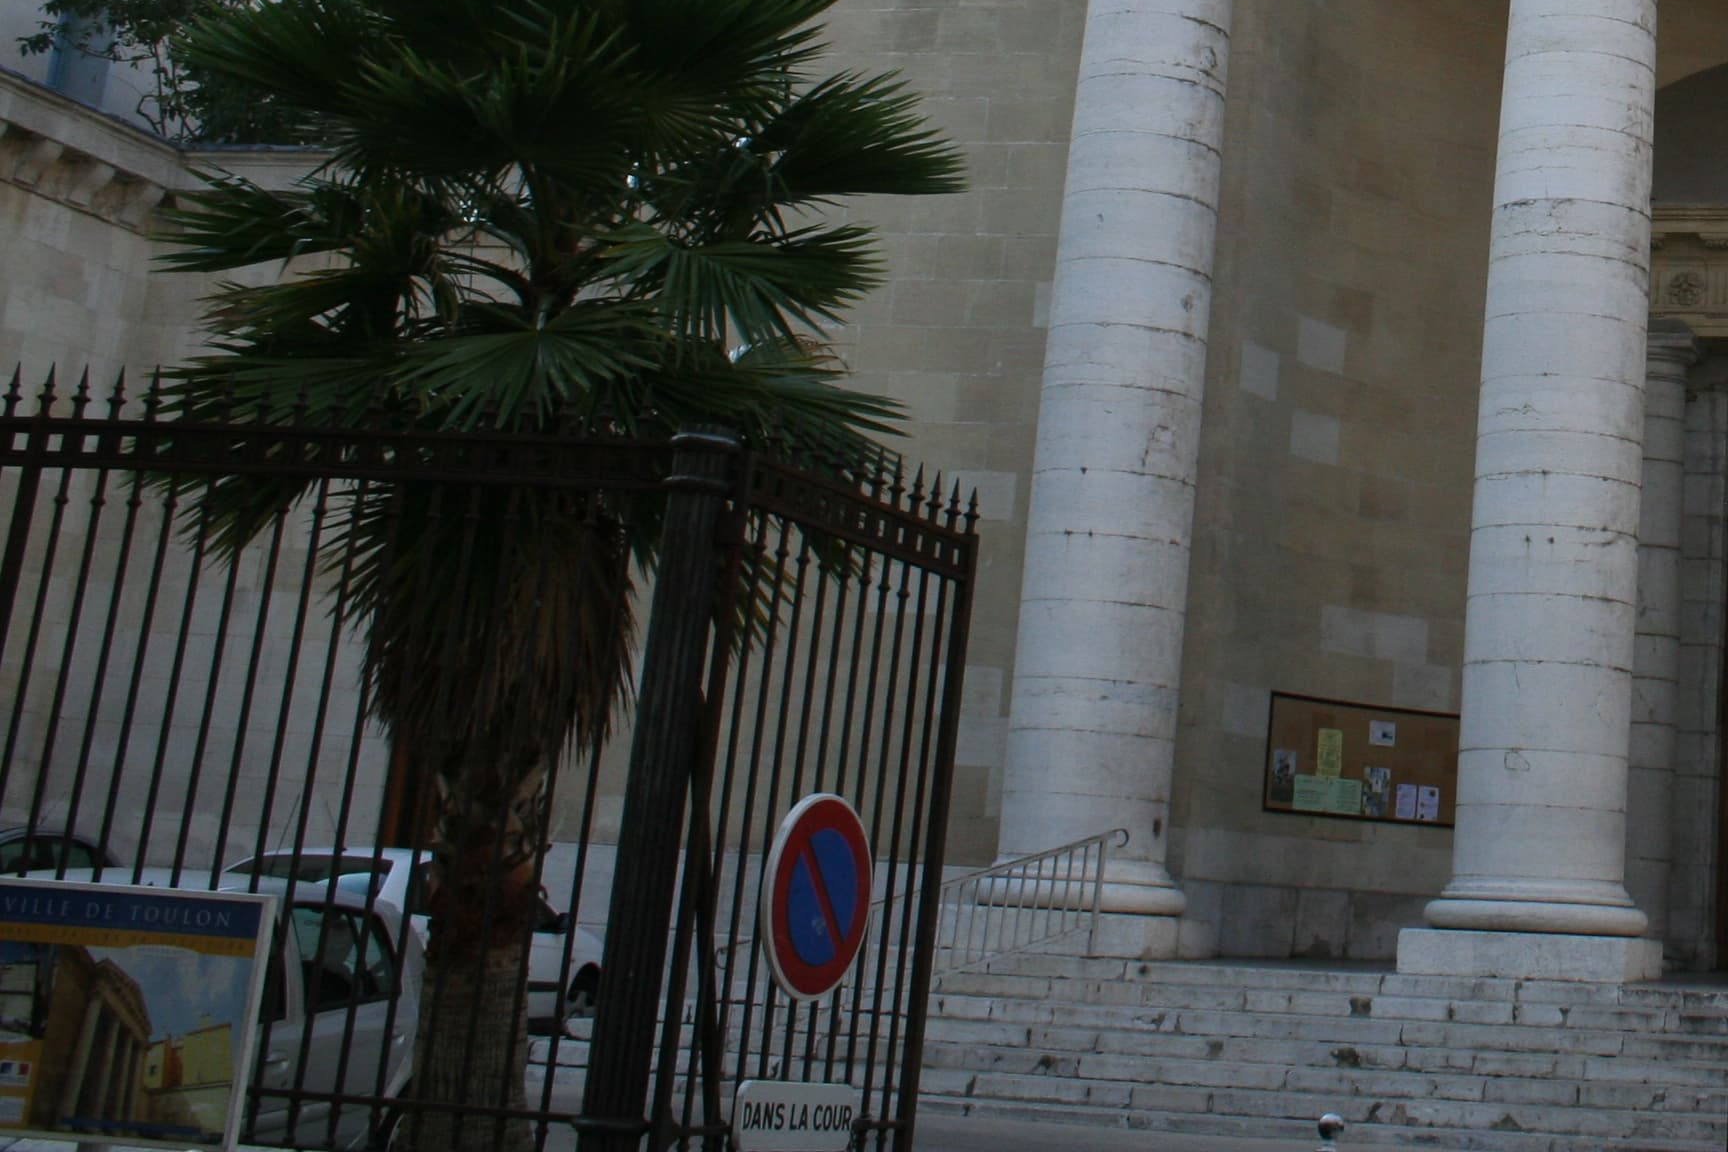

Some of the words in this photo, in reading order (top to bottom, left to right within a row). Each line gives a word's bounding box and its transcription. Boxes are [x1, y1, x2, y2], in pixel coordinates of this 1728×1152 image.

[3, 895, 71, 917] VILLE
[85, 901, 115, 920] DE
[130, 905, 232, 927] TOULON
[742, 1102, 786, 1130] DANS
[789, 1103, 808, 1130] LA
[813, 1104, 852, 1131] COUR
